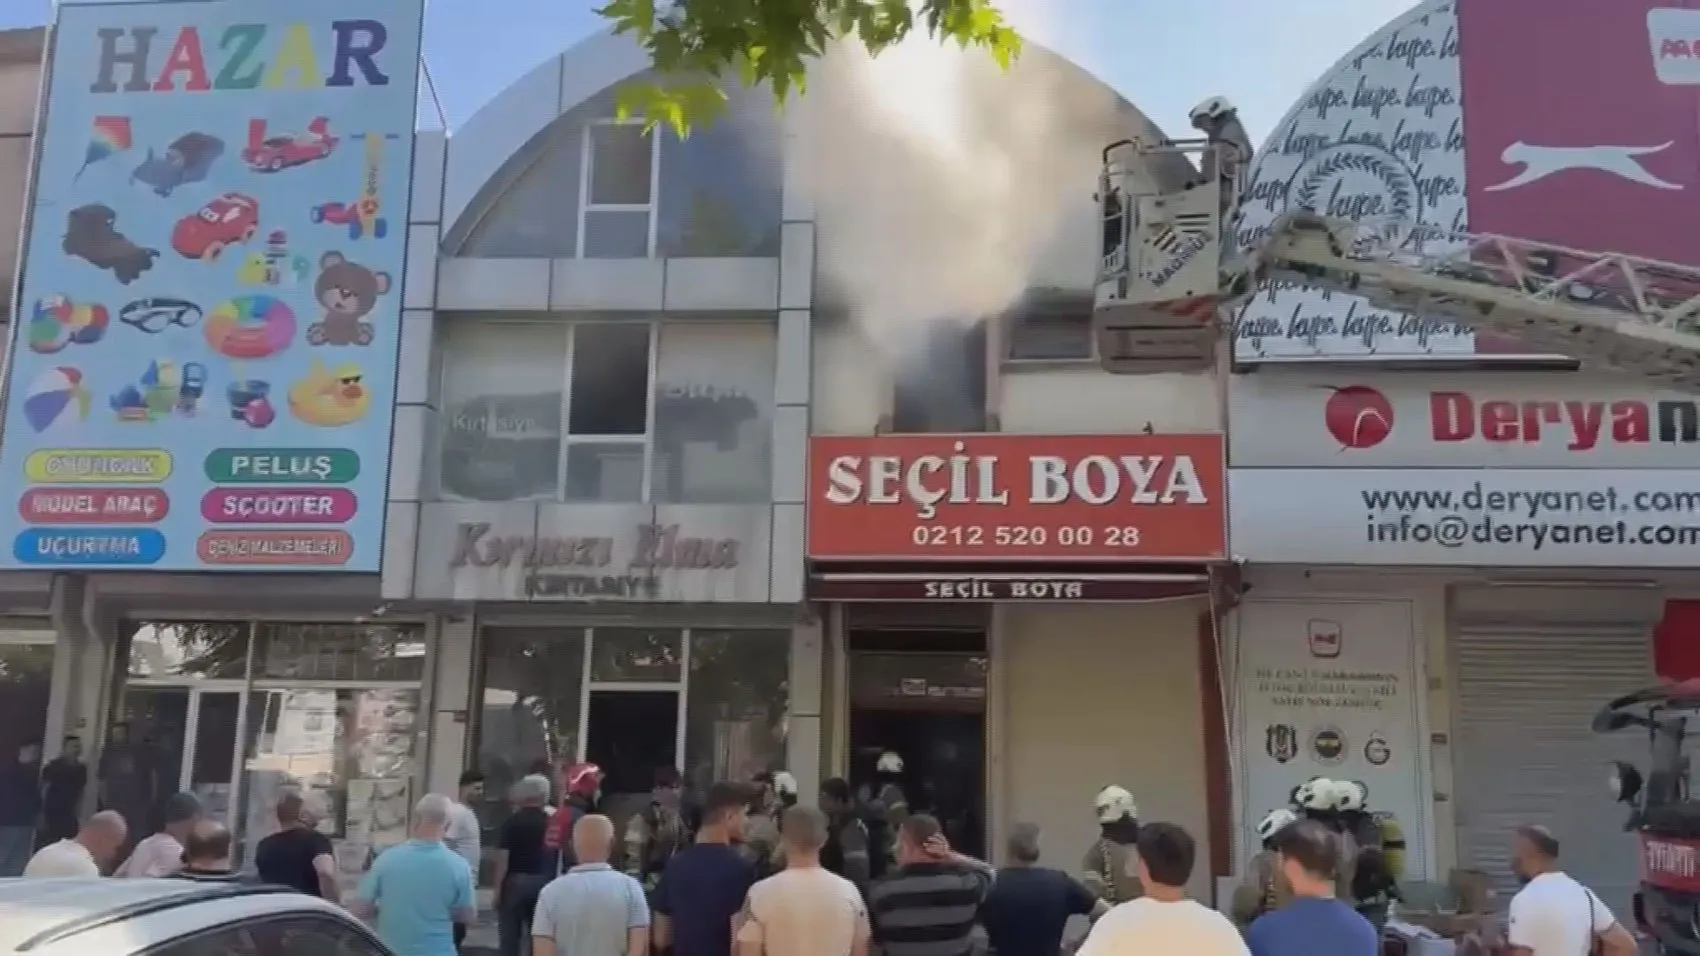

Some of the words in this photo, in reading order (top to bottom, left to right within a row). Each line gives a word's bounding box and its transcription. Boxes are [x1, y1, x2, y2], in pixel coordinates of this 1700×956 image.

[90, 19, 390, 93] HAZAR
[231, 455, 332, 479] PELUŞ
[824, 441, 1010, 518] SEÇİL
[1028, 455, 1208, 504] BOYA
[912, 526, 984, 546] 0212
[995, 526, 1046, 546] 520
[1057, 526, 1093, 546] 00
[1104, 526, 1141, 546] 28
[925, 579, 993, 599] SEÇİL
[1011, 581, 1083, 598] BOYA
